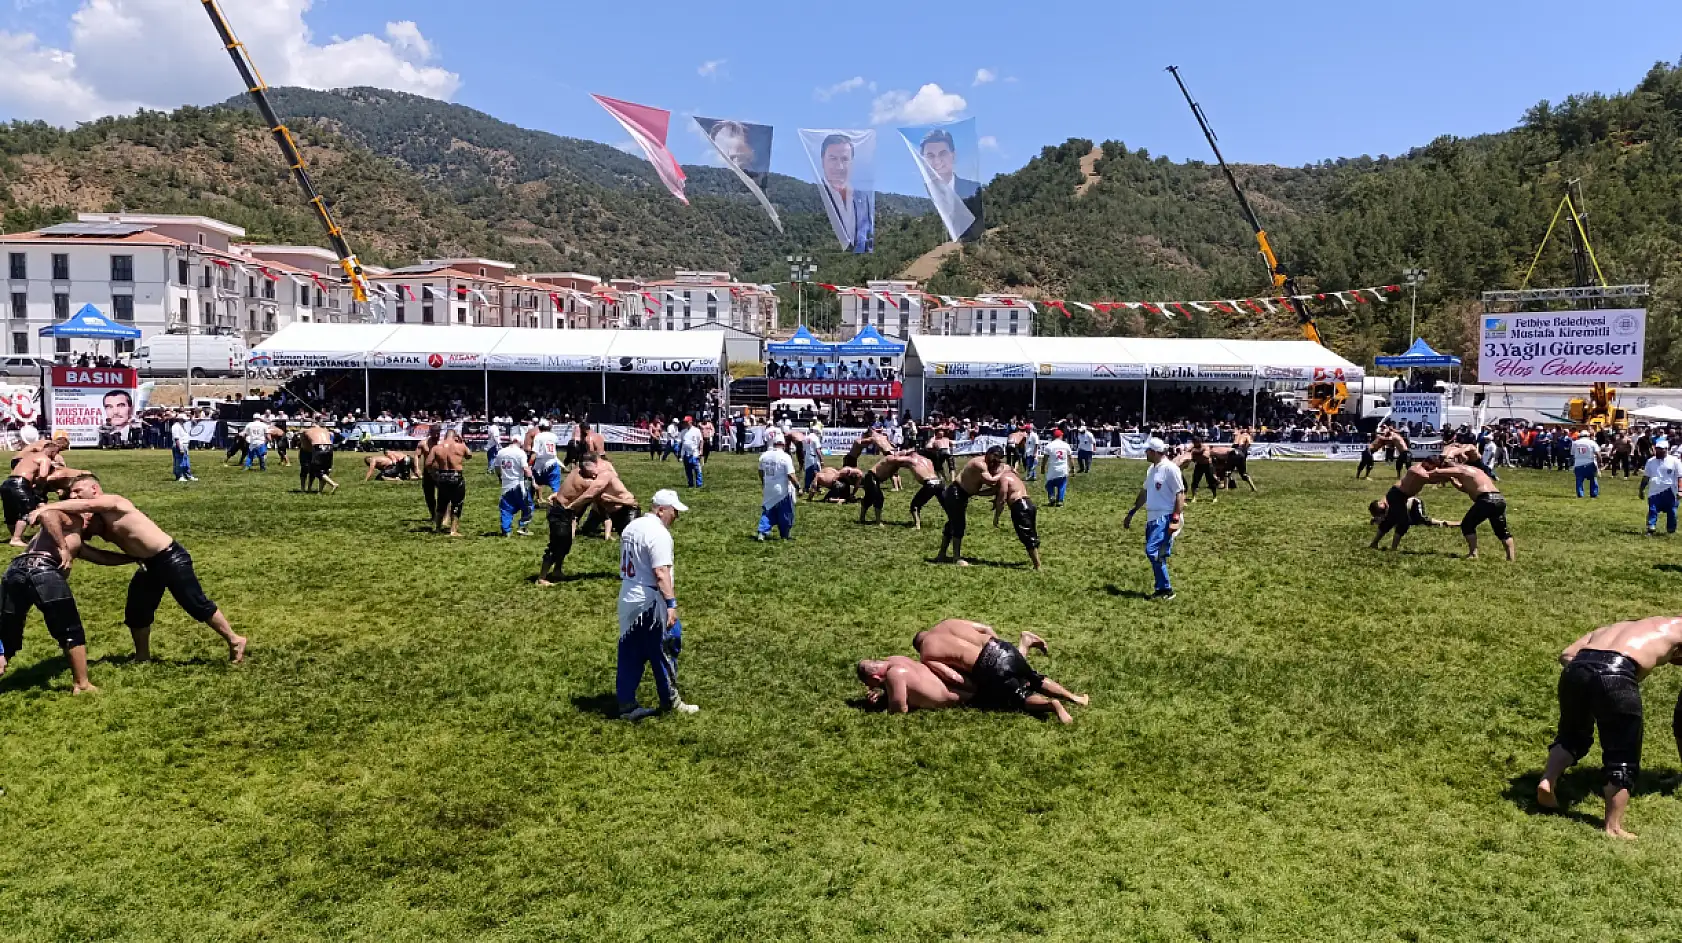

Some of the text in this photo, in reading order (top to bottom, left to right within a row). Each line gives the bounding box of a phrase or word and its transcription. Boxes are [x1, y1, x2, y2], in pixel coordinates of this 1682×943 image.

[1553, 315, 1606, 328] Belediyesi
[1511, 329, 1555, 339] Mustafa
[1559, 327, 1610, 338] Kiremitli
[1484, 342, 1546, 361] 3.Yağlı
[273, 359, 305, 367] ESNAF
[662, 361, 691, 372] LOV
[1494, 357, 1624, 377] Hoş Geldiniz
[65, 371, 124, 385] BASIN
[779, 383, 892, 397] HAKEM HEYETİ
[55, 408, 103, 416] MUSTAFA
